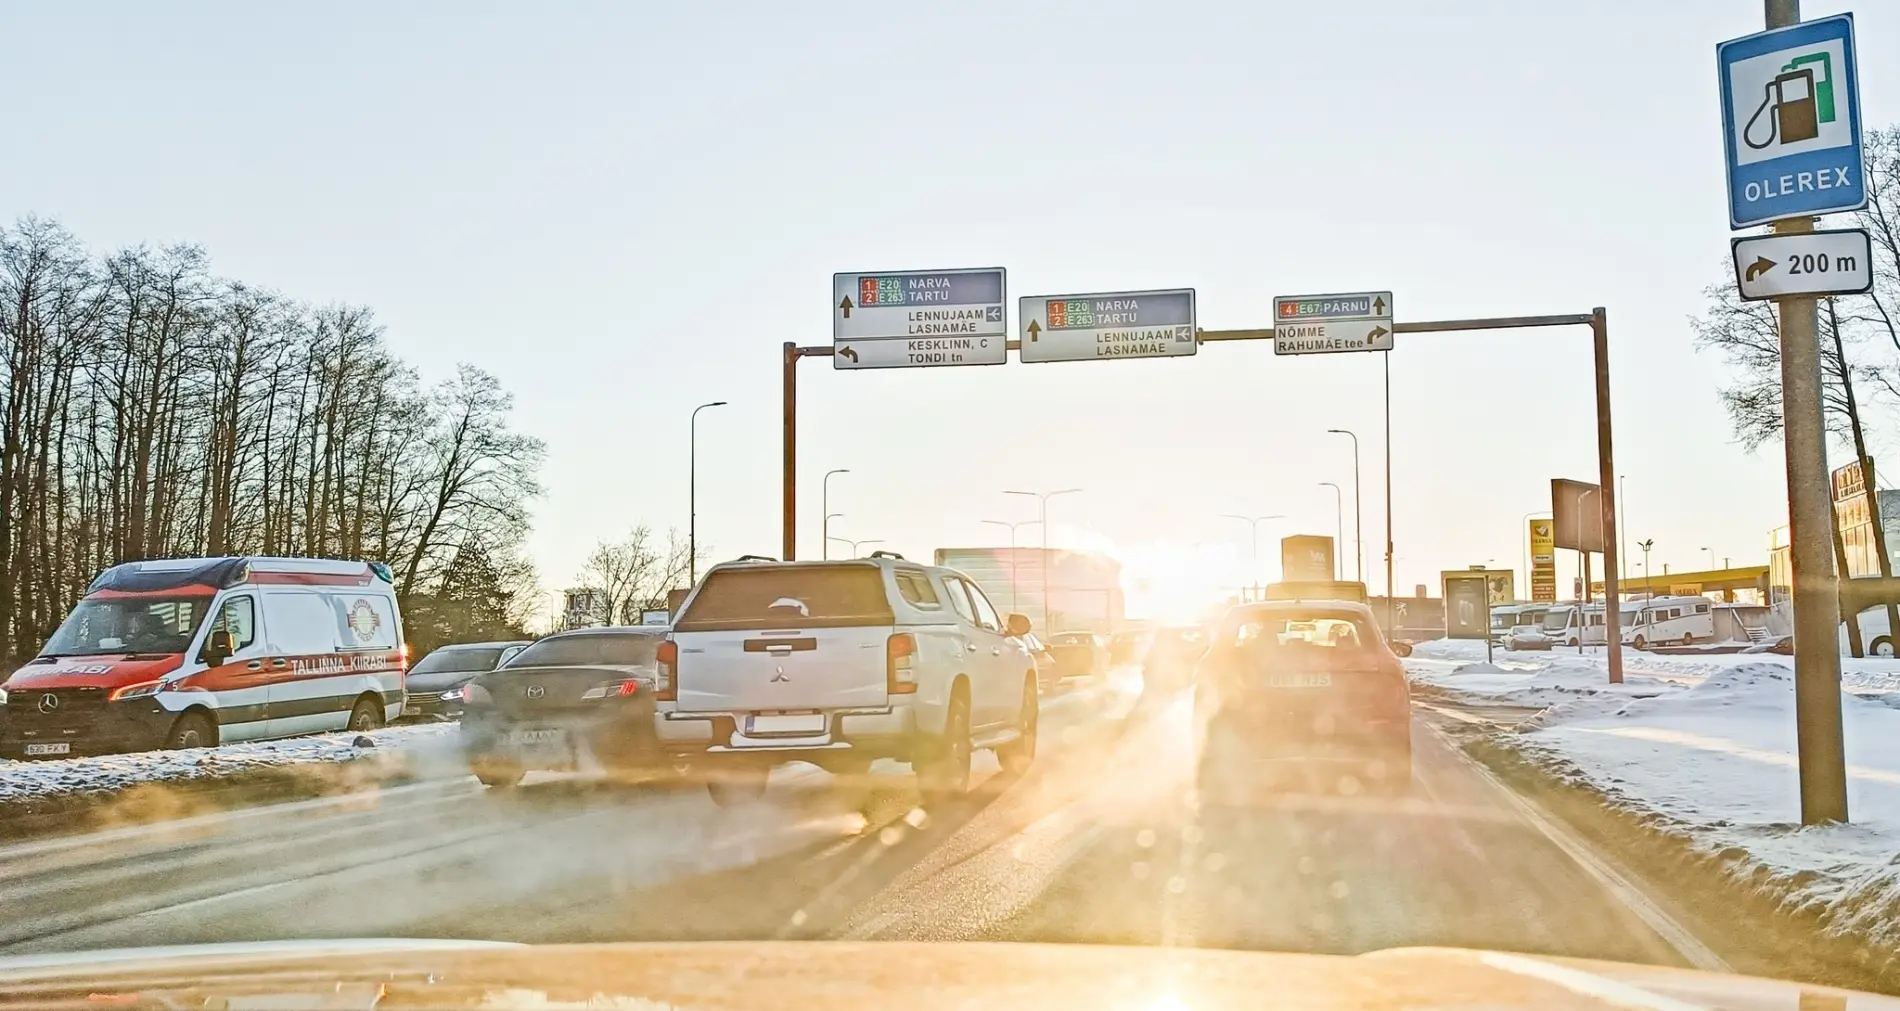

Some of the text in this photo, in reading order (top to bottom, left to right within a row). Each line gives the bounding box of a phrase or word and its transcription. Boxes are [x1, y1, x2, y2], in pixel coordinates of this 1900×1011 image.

[1744, 166, 1851, 202] OLEREX
[1788, 253, 1856, 275] 200 m
[880, 280, 899, 290] E20
[909, 278, 951, 289] NARVA
[866, 294, 873, 303] 2
[909, 290, 949, 301] TARTU
[1067, 302, 1088, 312] E20
[1096, 300, 1138, 311] NARVA
[1286, 305, 1292, 314] 4
[1300, 303, 1320, 314] E67
[908, 309, 984, 321] LENNUJAAM
[1055, 317, 1061, 325] 2
[1097, 312, 1137, 324] TARTU
[908, 320, 976, 334] LASNAMÄE
[1278, 326, 1325, 339] NÕMME
[1097, 329, 1173, 343] LENNUJAAM
[908, 339, 988, 351] KESKLINN, C
[1097, 341, 1166, 356] LASNAMÄE
[1278, 337, 1364, 352] RAHUMÄE tee
[908, 354, 963, 363] TONDI tn
[291, 655, 387, 675] TALLINNA KIIRABI
